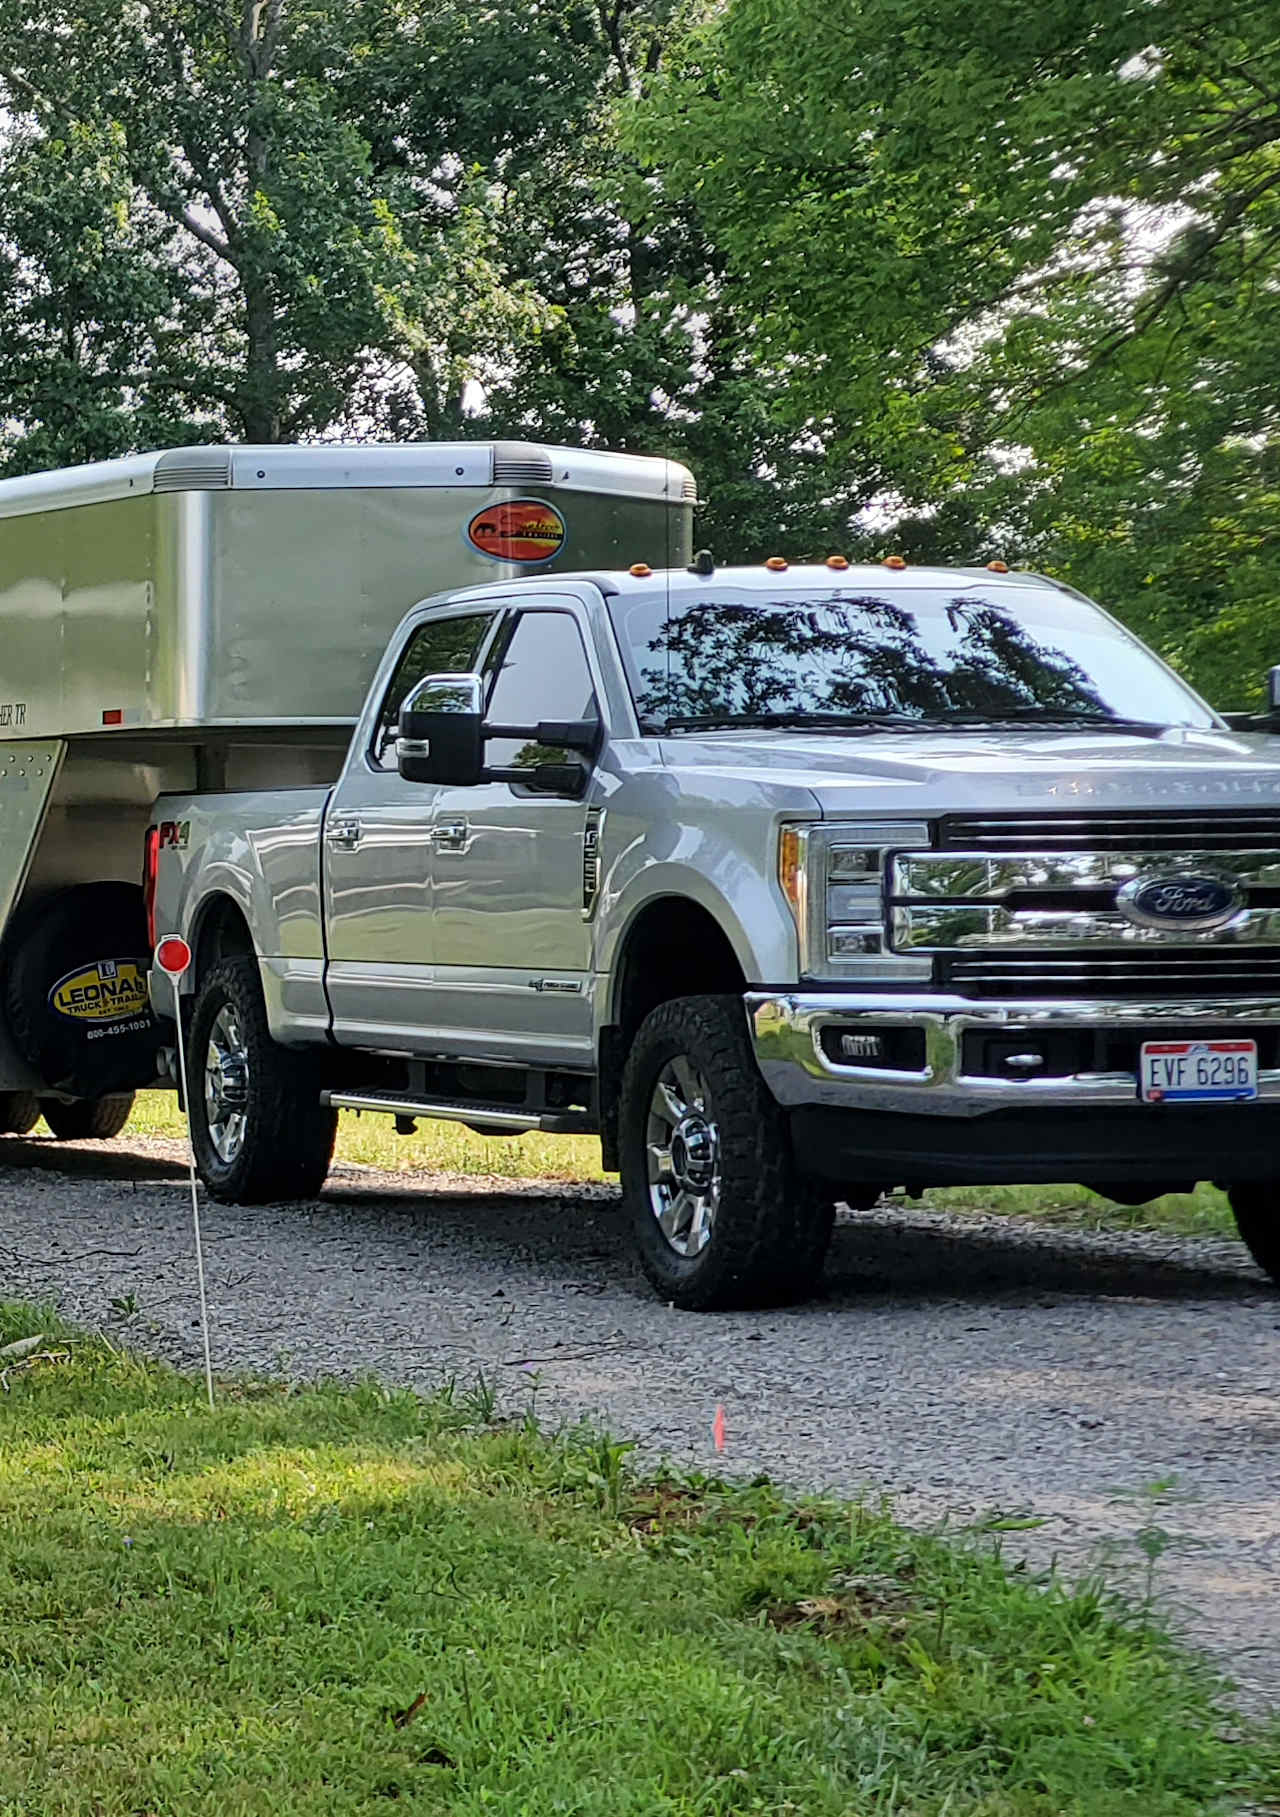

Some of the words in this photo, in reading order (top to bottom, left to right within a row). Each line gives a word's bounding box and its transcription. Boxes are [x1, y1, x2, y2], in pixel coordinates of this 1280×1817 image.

[15, 703, 27, 725] TR
[159, 821, 191, 848] FX4
[1154, 886, 1216, 912] Ford
[66, 1000, 102, 1015] TRUCK
[1150, 1058, 1189, 1087] EVF
[1197, 1056, 1249, 1086] 6296
